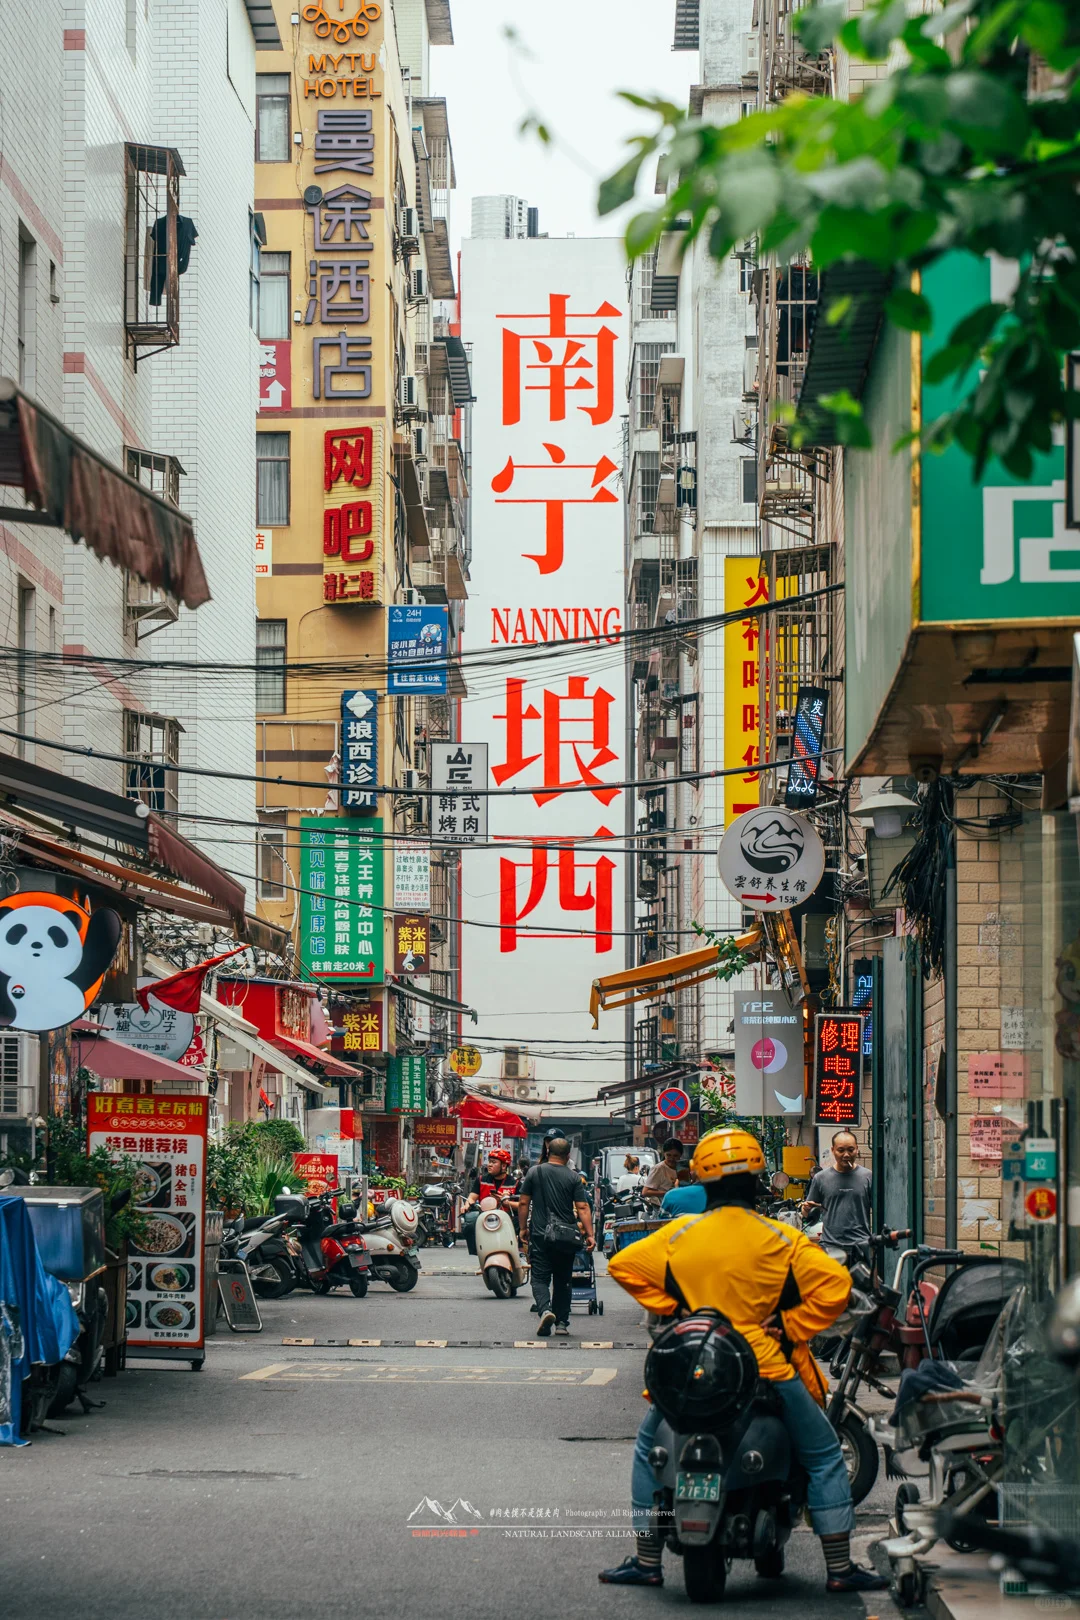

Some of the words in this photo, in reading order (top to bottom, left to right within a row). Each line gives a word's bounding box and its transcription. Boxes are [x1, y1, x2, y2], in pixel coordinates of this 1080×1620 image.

[308, 53, 376, 73] MYTU
[303, 78, 382, 99] HOTEL
[303, 109, 375, 400] 曼途酒店
[490, 292, 623, 576] 南宁
[322, 426, 374, 563] 网吧
[406, 609, 422, 617] 24H
[490, 607, 623, 645] NANNING
[346, 720, 374, 806] 埌西诊所
[438, 815, 479, 834] 烤肉
[490, 675, 623, 954] 埌西
[778, 894, 798, 905] 15米
[397, 926, 427, 941] 紫米
[311, 960, 366, 972] 往前走20米
[342, 1013, 380, 1032] 紫米
[343, 1032, 380, 1051] 飯團
[819, 1019, 859, 1053] 修理
[105, 1136, 188, 1155] 特色推荐榜
